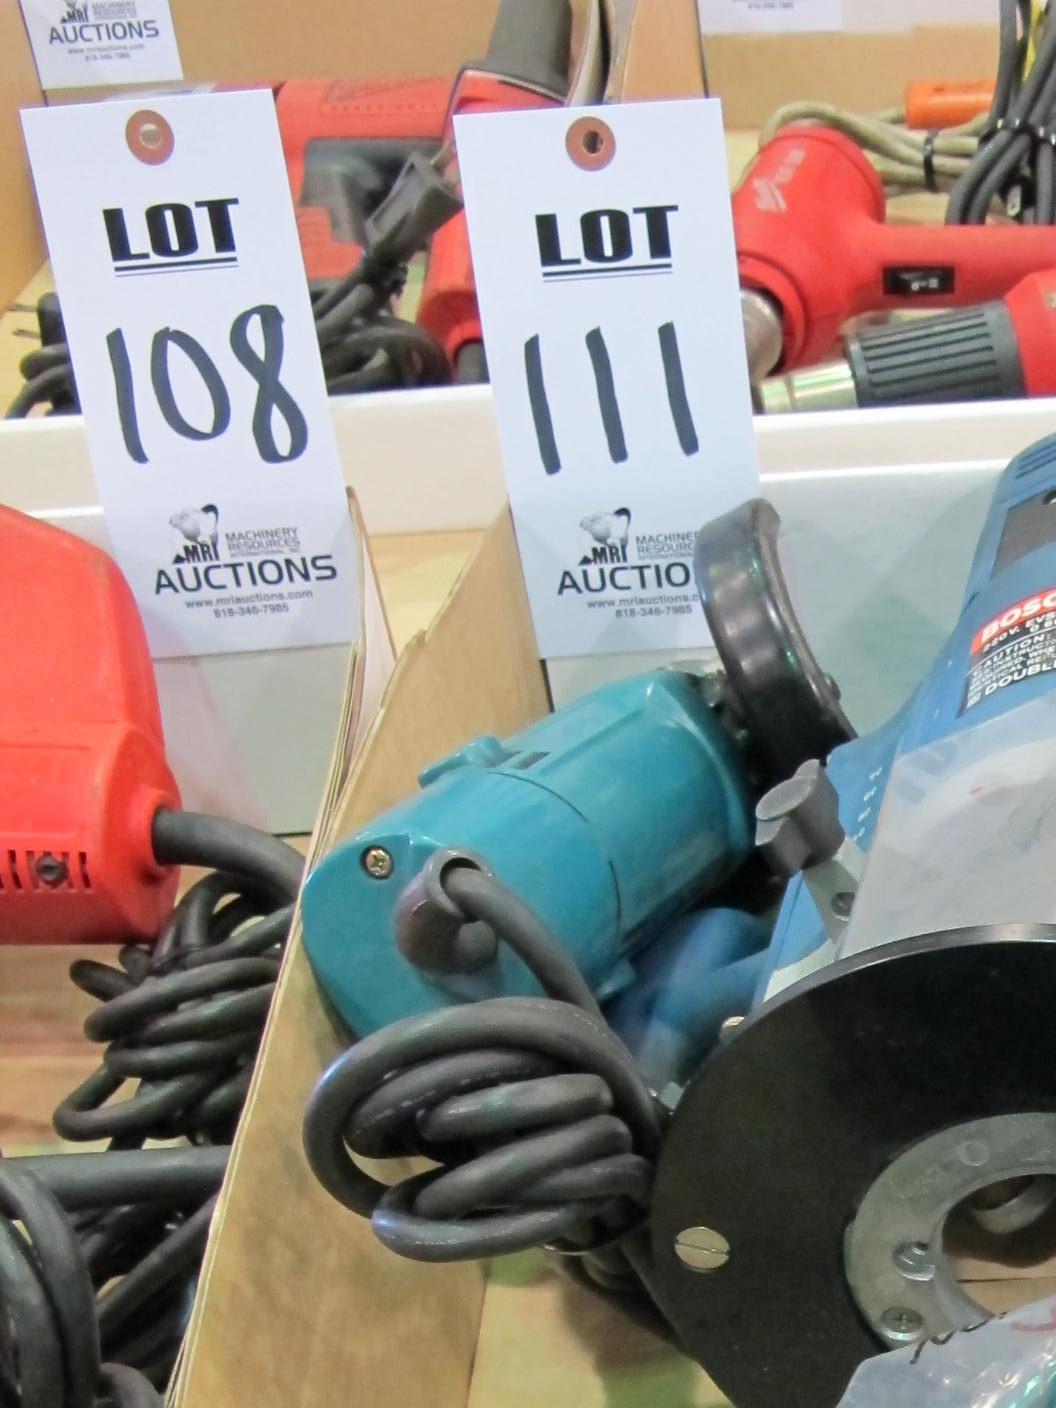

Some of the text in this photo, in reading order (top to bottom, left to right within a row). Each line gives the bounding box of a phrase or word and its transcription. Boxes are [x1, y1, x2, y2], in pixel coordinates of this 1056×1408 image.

[49, 20, 160, 45] AUCTIONS
[102, 197, 240, 263] LOT
[534, 204, 680, 268] LOT
[106, 303, 309, 465] 108
[523, 320, 700, 477] 111
[225, 526, 299, 543] MACHINERY
[635, 531, 699, 545] MACHINE
[182, 542, 221, 564] MRI
[228, 538, 301, 553] RESOURCES
[590, 544, 630, 565] MRI
[636, 541, 695, 555] RESOURC
[155, 555, 338, 596] AUCTIONS
[557, 562, 692, 596] AUCTIO
[184, 589, 314, 609] www.mriauctions.com
[586, 593, 700, 610] www.mriauctions.c
[214, 602, 290, 619] 818-346-7985
[1024, 611, 1056, 628] EVS
